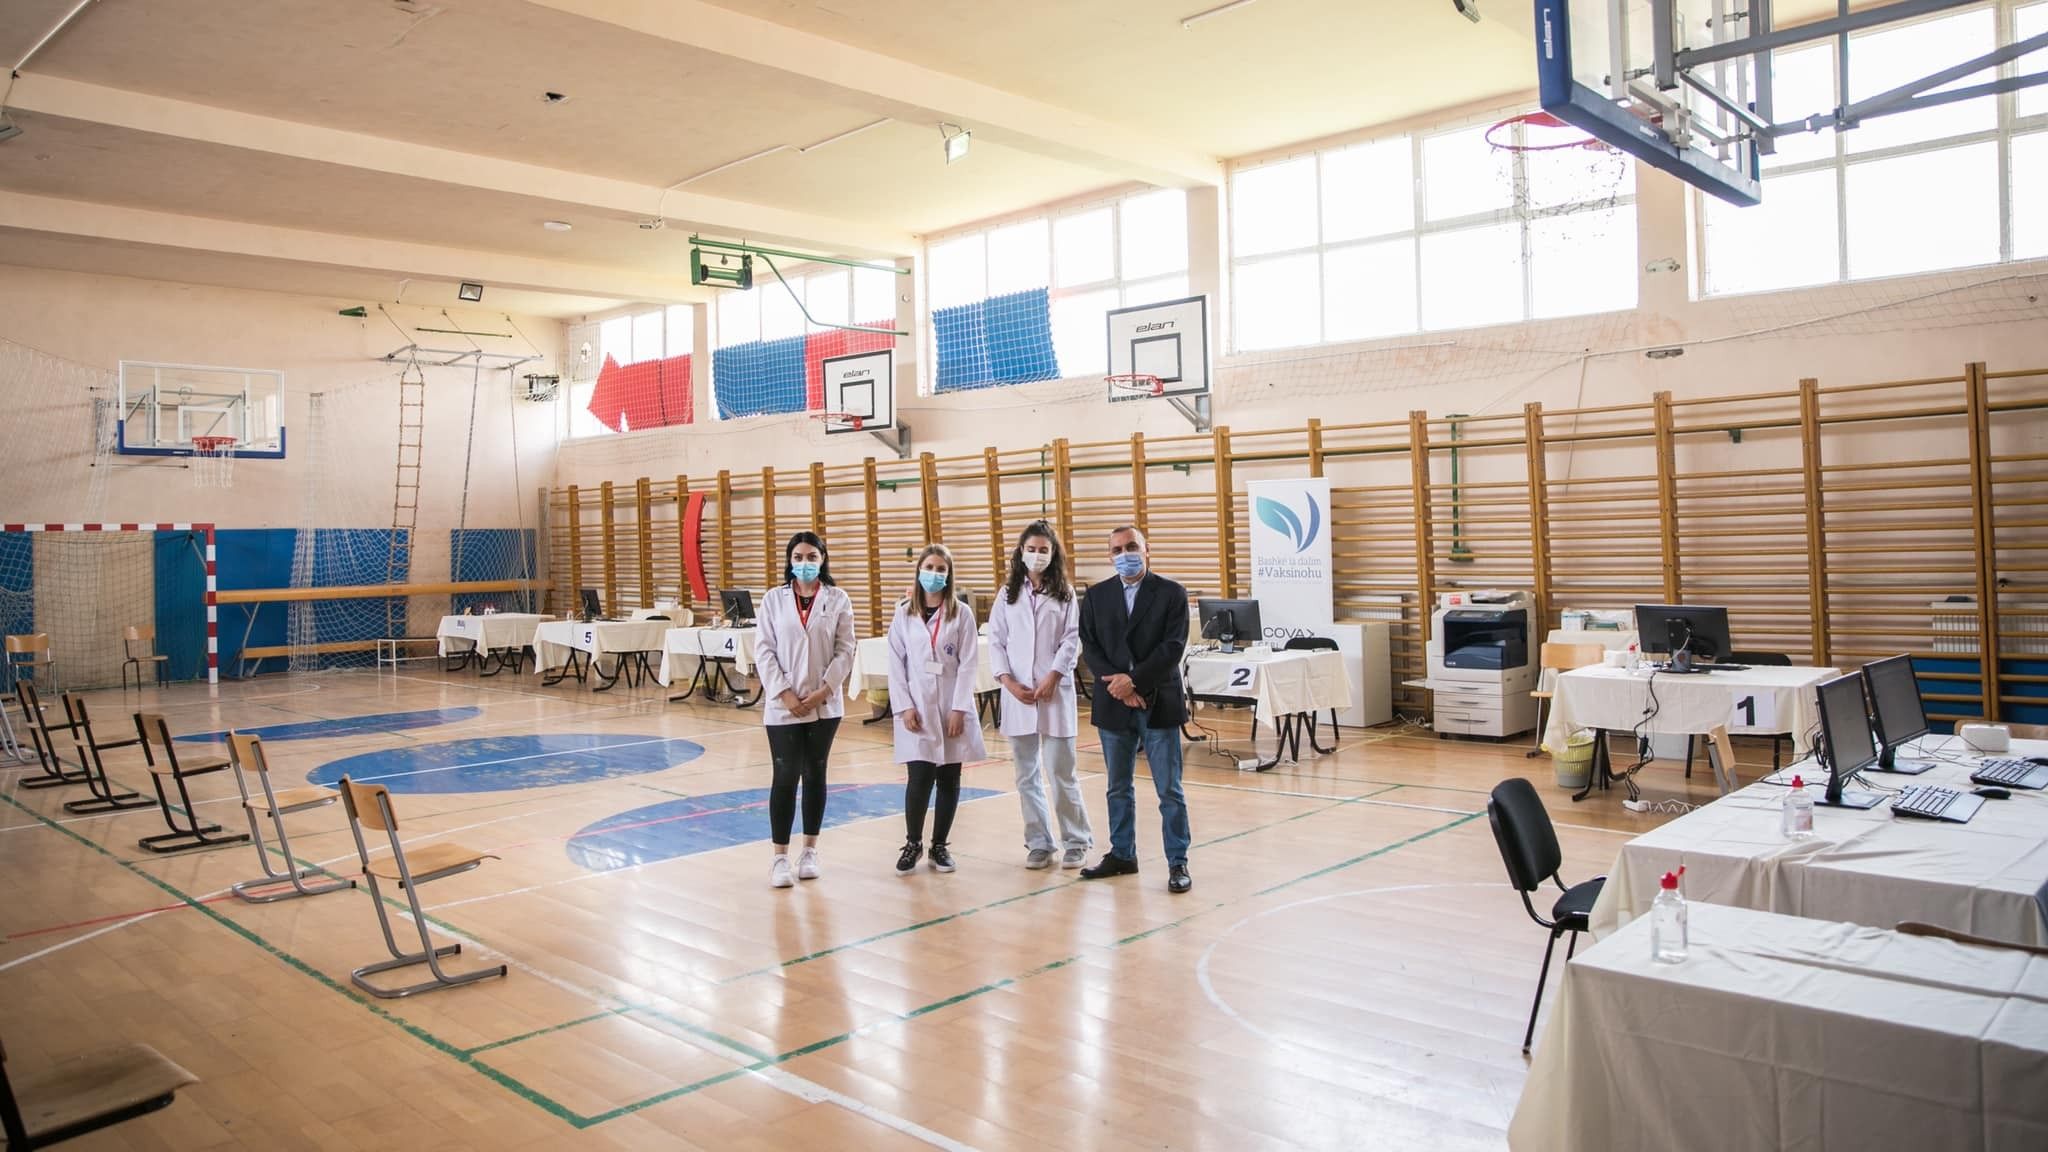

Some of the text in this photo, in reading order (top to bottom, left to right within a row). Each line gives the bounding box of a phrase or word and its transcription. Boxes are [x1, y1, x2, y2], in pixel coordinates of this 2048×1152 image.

[1136, 321, 1175, 333] elan
[843, 369, 870, 378] elan
[1258, 567, 1322, 578] #Vaksinohu
[585, 632, 592, 643] 5
[725, 638, 734, 651] 4
[1231, 667, 1251, 687] 2
[1737, 696, 1755, 726] 1
